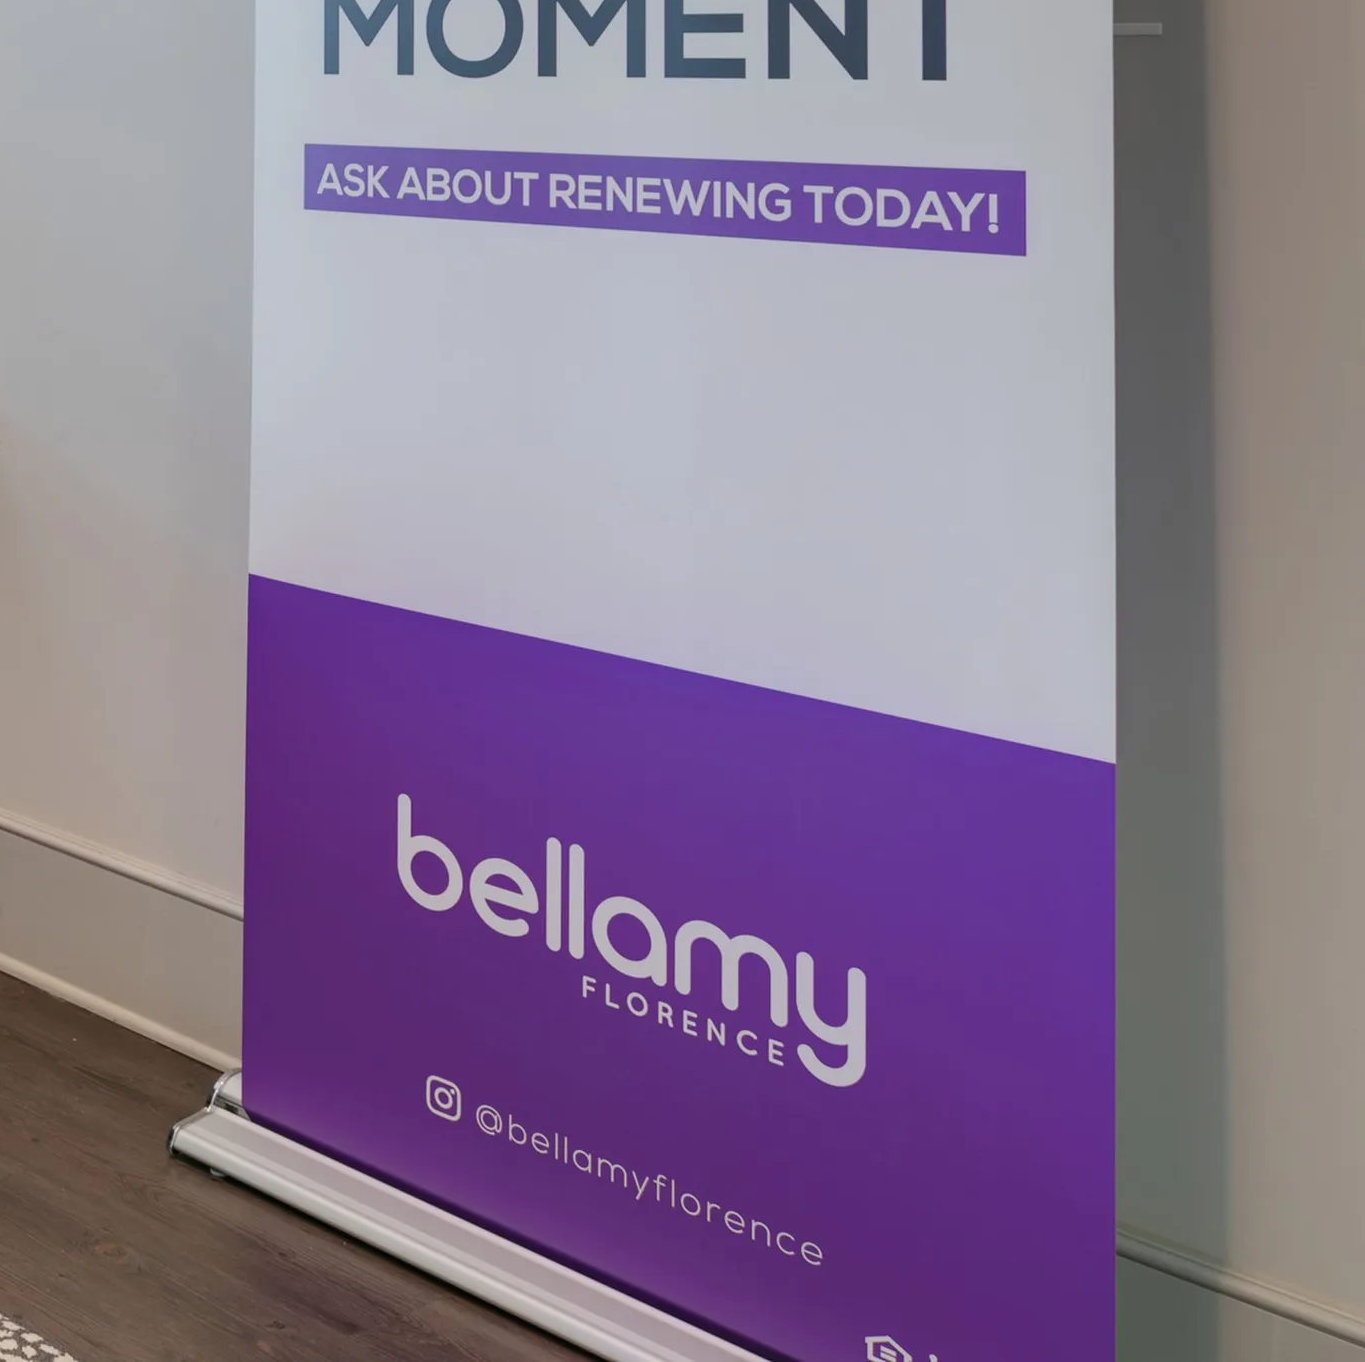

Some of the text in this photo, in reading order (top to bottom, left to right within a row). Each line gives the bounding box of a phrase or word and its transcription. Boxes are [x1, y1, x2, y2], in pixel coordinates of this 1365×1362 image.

[316, 162, 999, 233] ASK ABOUT RENEWING TODAY!
[397, 793, 867, 1088] bellamy
[581, 974, 786, 1067] FLORENCE
[475, 1103, 825, 1268] @bellamyflorence
